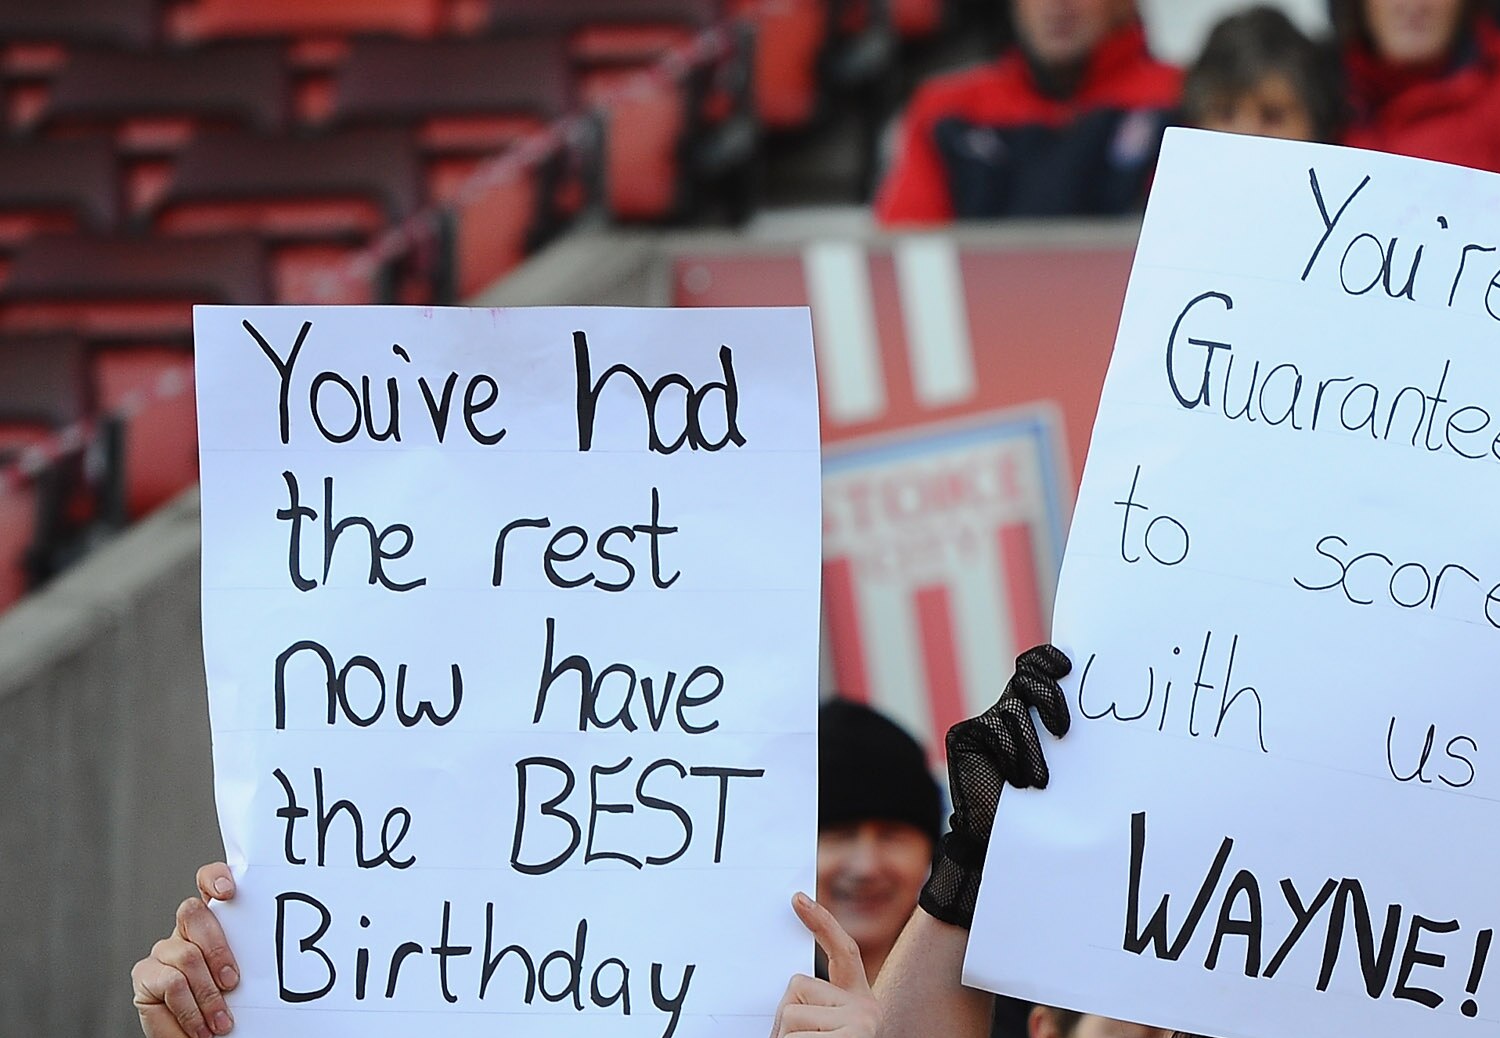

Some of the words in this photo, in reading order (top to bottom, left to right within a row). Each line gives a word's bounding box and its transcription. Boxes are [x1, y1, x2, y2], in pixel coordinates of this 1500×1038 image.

[242, 319, 507, 446] You've
[572, 330, 747, 455] had
[276, 470, 427, 592] the
[492, 487, 681, 592] rest
[1114, 465, 1189, 566] to
[274, 640, 463, 731] now
[532, 617, 725, 734] have
[1078, 631, 1268, 753] with
[1386, 716, 1479, 788] us
[272, 767, 417, 870] the
[510, 756, 765, 876] BEST
[1122, 811, 1493, 1018] WAYNE!
